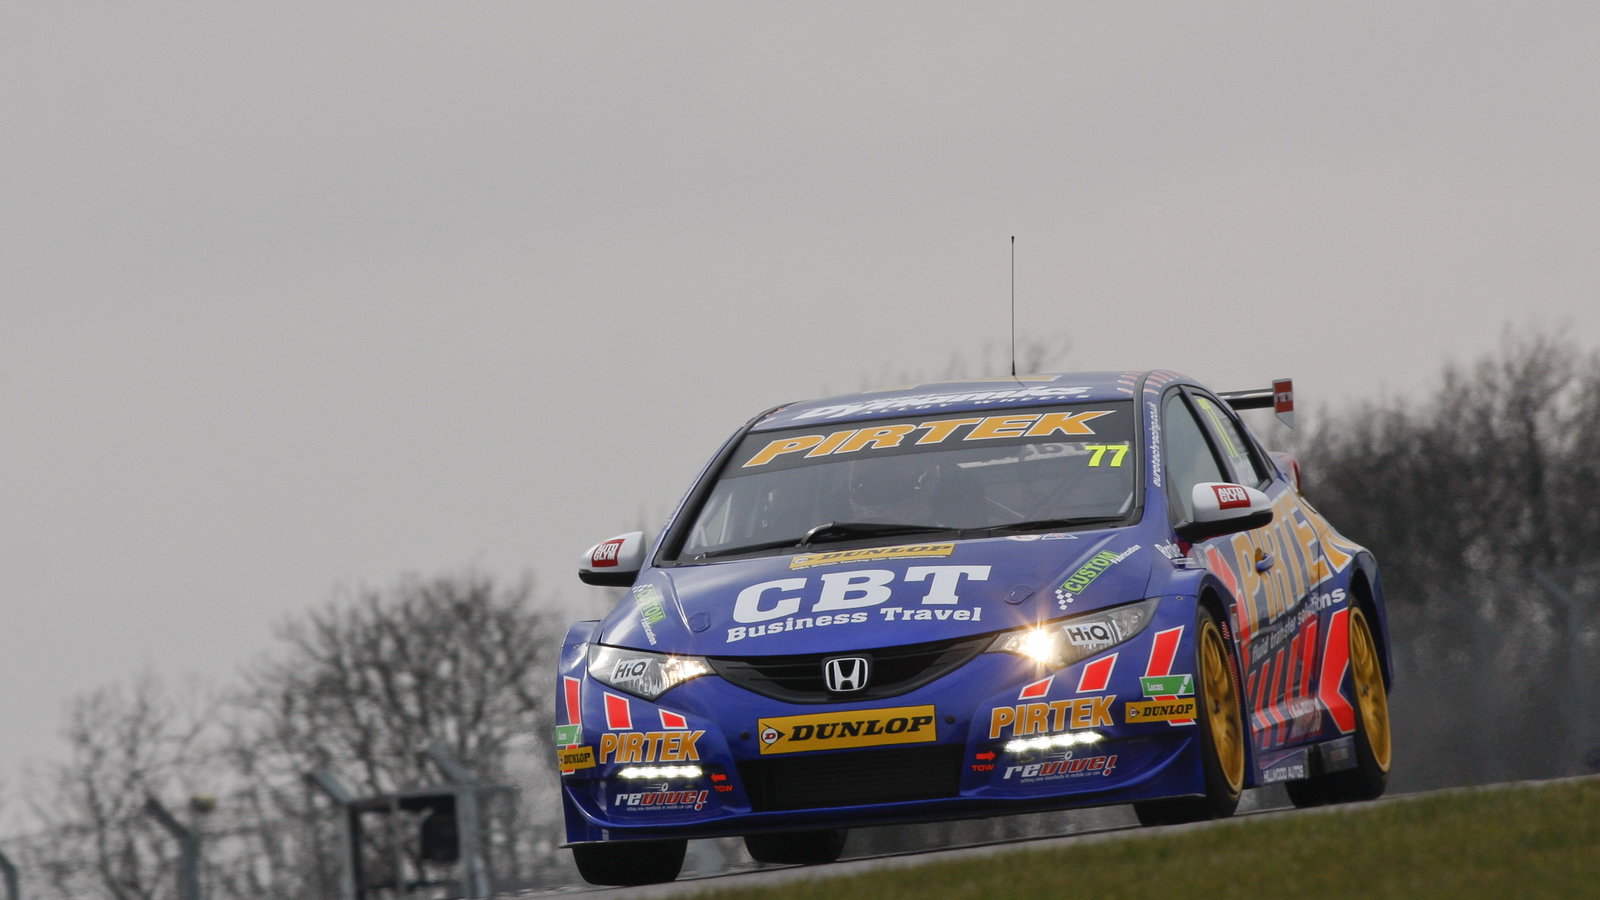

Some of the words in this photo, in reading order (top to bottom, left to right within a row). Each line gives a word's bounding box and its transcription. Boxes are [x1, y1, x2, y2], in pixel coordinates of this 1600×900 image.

[792, 386, 1093, 420] Dynamics
[741, 410, 1117, 468] PIRTEK
[1085, 445, 1129, 467] 77
[821, 545, 952, 560] DUNLOP
[1063, 550, 1120, 593] CUSTOM
[733, 565, 991, 624] CBT
[726, 611, 868, 643] Business
[880, 607, 981, 622] Travel
[1068, 624, 1110, 641] HiQ
[614, 660, 647, 678] HiQ
[989, 695, 1117, 739] PIRTEK
[1143, 703, 1193, 717] DUNLOP
[788, 716, 933, 741] DUNLOP
[564, 752, 590, 764] DUNLOP
[599, 730, 706, 764] PIRTEK
[971, 764, 995, 772] TOW
[1003, 755, 1117, 779] revive!
[615, 790, 709, 811] revive!
